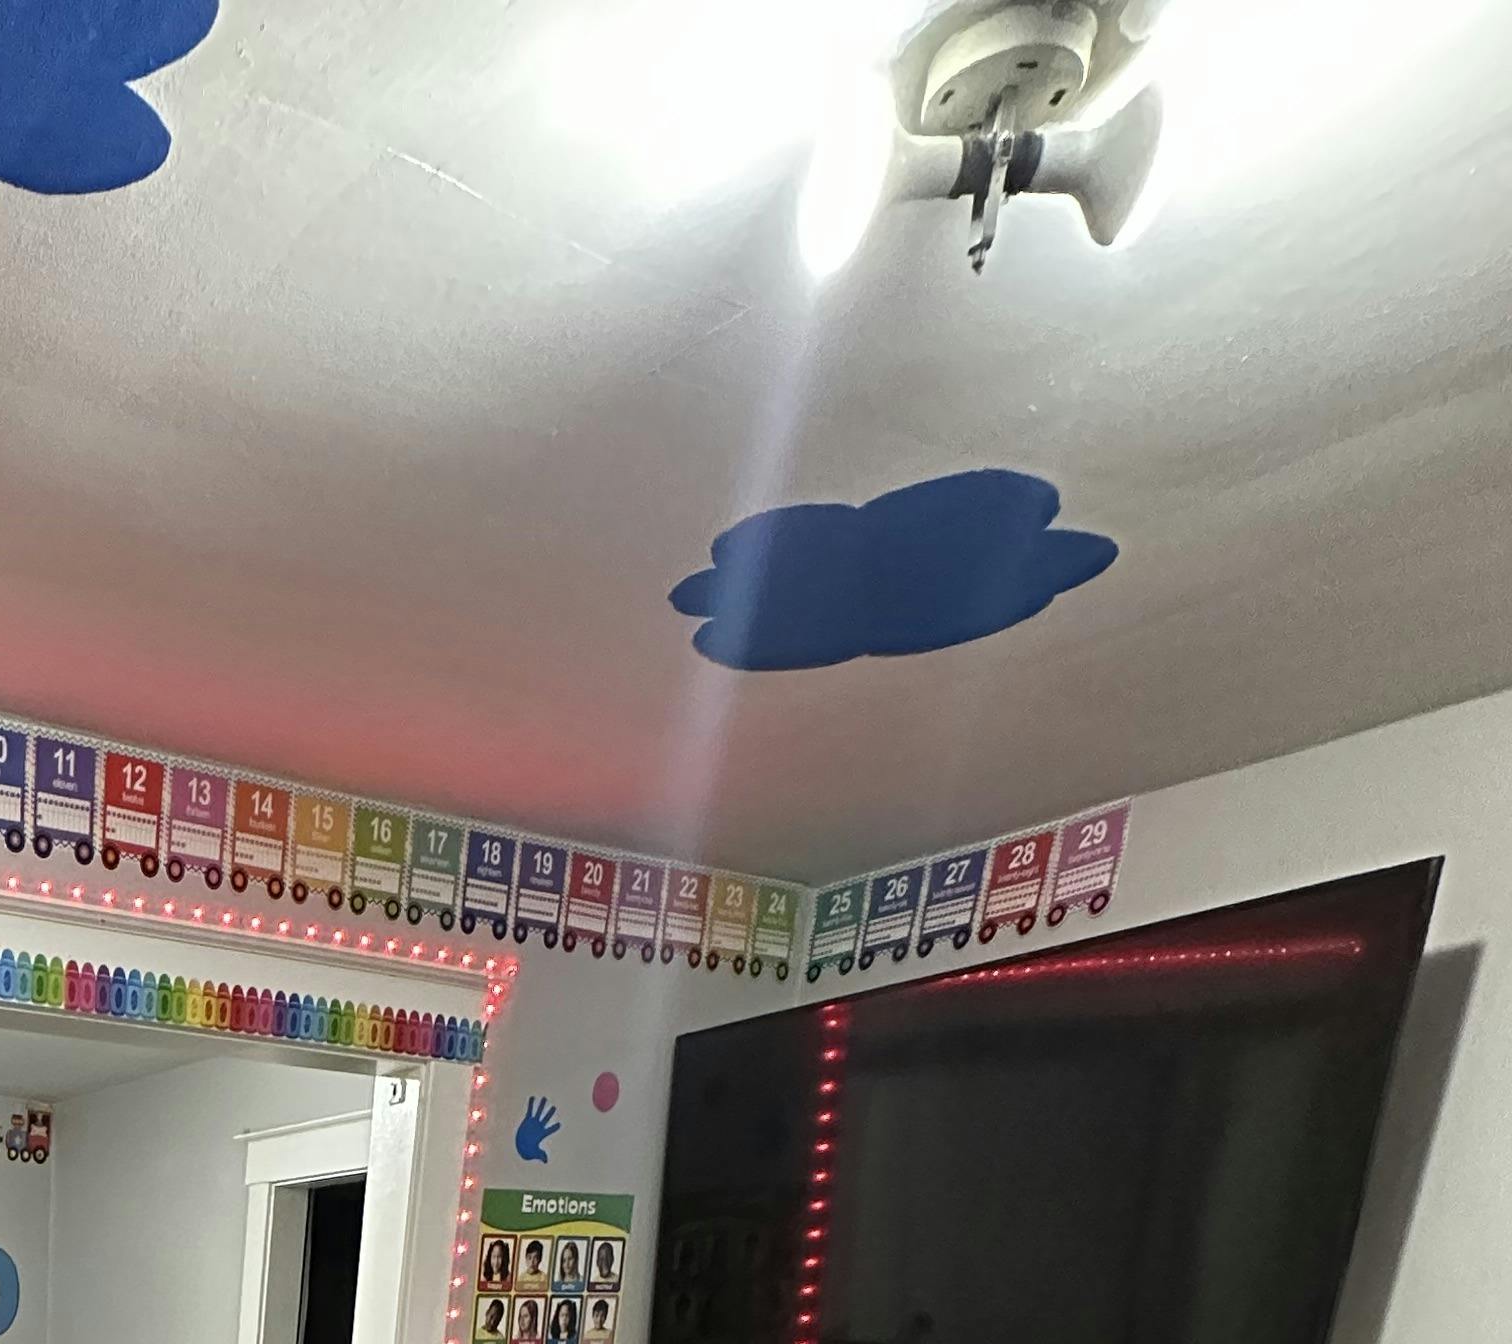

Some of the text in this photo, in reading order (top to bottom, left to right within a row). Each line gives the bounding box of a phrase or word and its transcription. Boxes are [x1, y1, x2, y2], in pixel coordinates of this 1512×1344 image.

[53, 748, 76, 778] 11
[122, 762, 147, 793] 12
[188, 777, 211, 806] 13
[251, 790, 273, 819] 14
[311, 803, 334, 832] 15
[371, 816, 392, 844] 16
[427, 828, 448, 855] 17
[1078, 819, 1108, 850] 29
[481, 839, 502, 866] 18
[533, 850, 553, 876] 19
[1007, 840, 1037, 870] 28
[583, 861, 603, 886] 20
[633, 869, 651, 893] 21
[943, 859, 971, 885] 27
[679, 875, 700, 899] 22
[726, 884, 744, 907] 23
[884, 875, 909, 901] 26
[768, 891, 787, 915] 24
[829, 893, 852, 916] 25
[521, 1194, 597, 1216] Emotions
